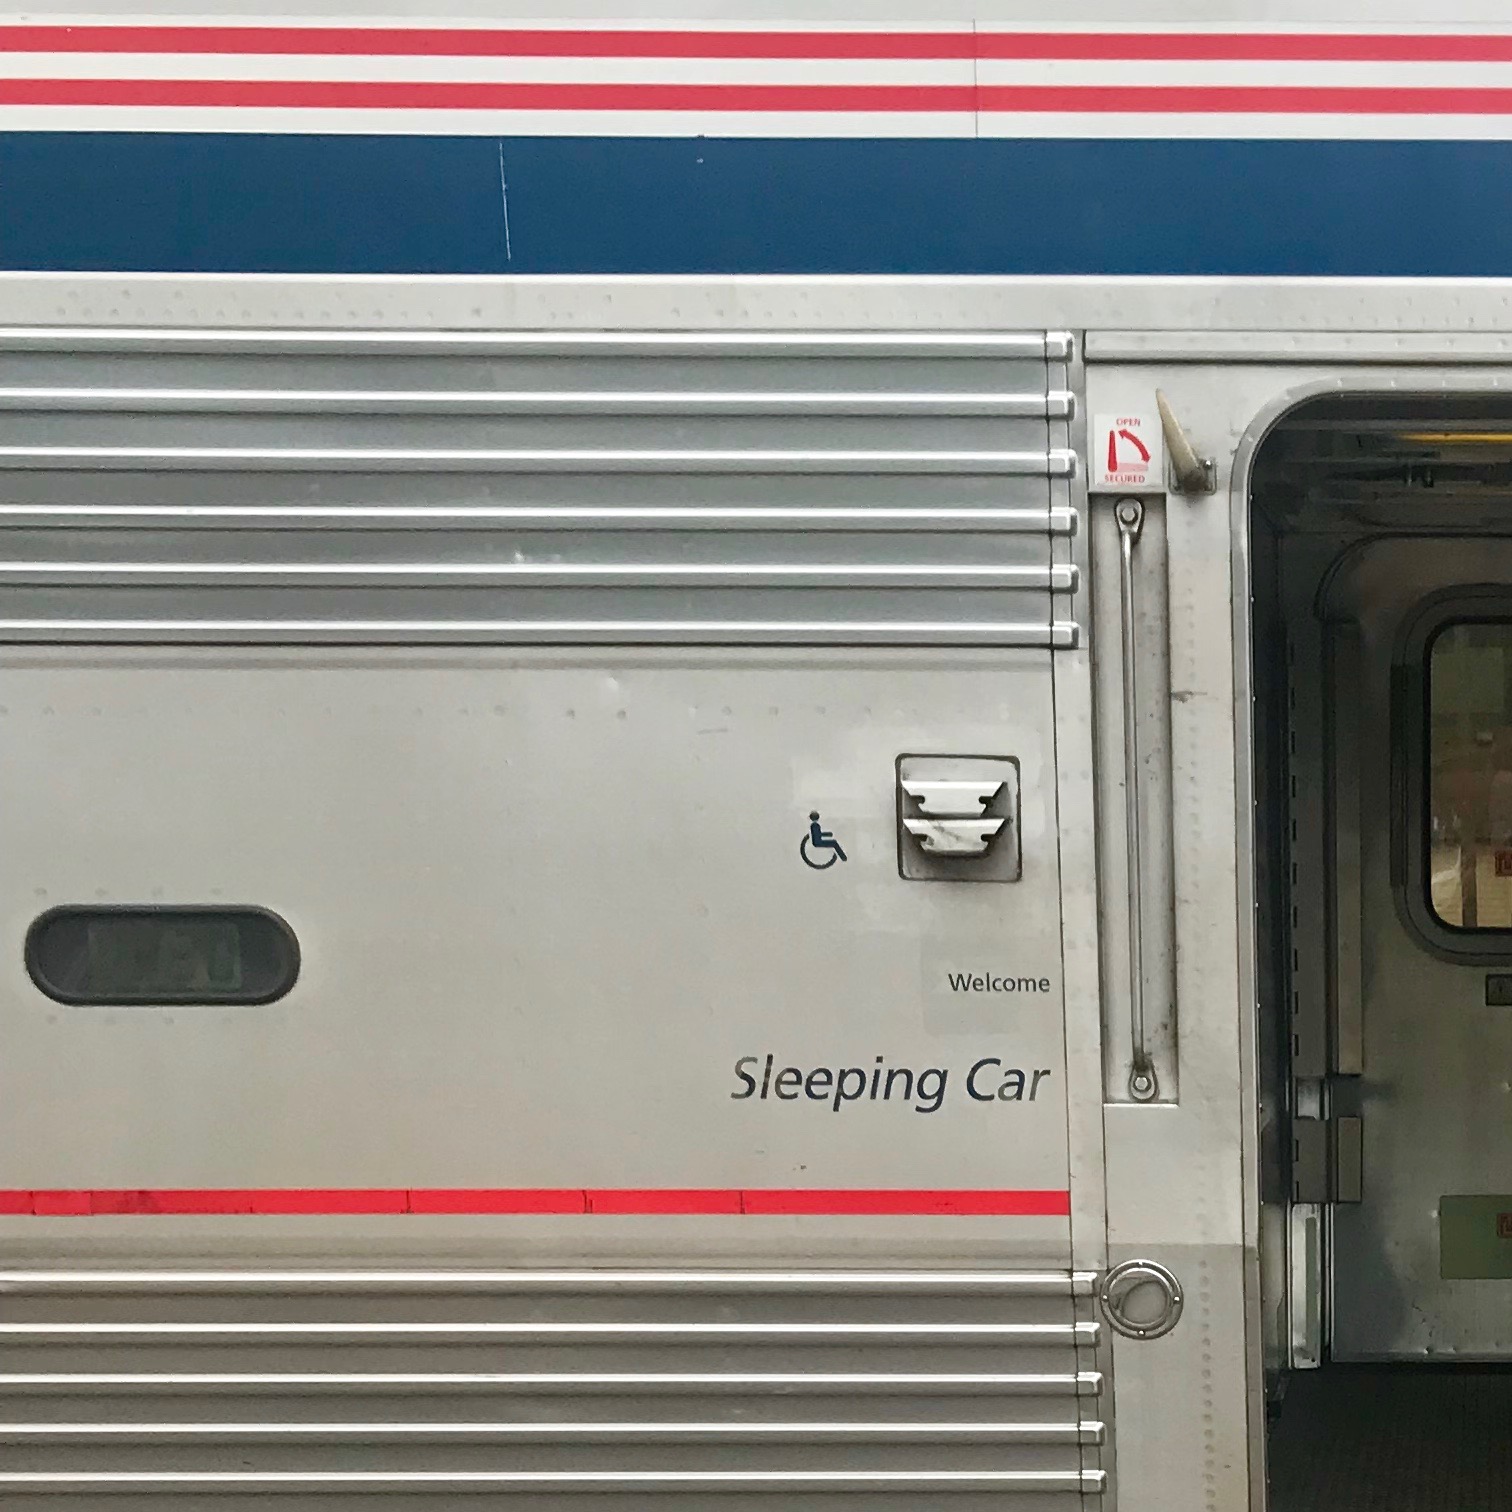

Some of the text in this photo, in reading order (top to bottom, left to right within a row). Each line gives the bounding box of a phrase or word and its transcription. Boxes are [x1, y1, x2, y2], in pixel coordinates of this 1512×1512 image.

[1116, 418, 1141, 427] OPEN
[1104, 474, 1146, 483] SECURED
[948, 972, 1051, 993] Welcome
[730, 1054, 1052, 1114] Sleeping Car
